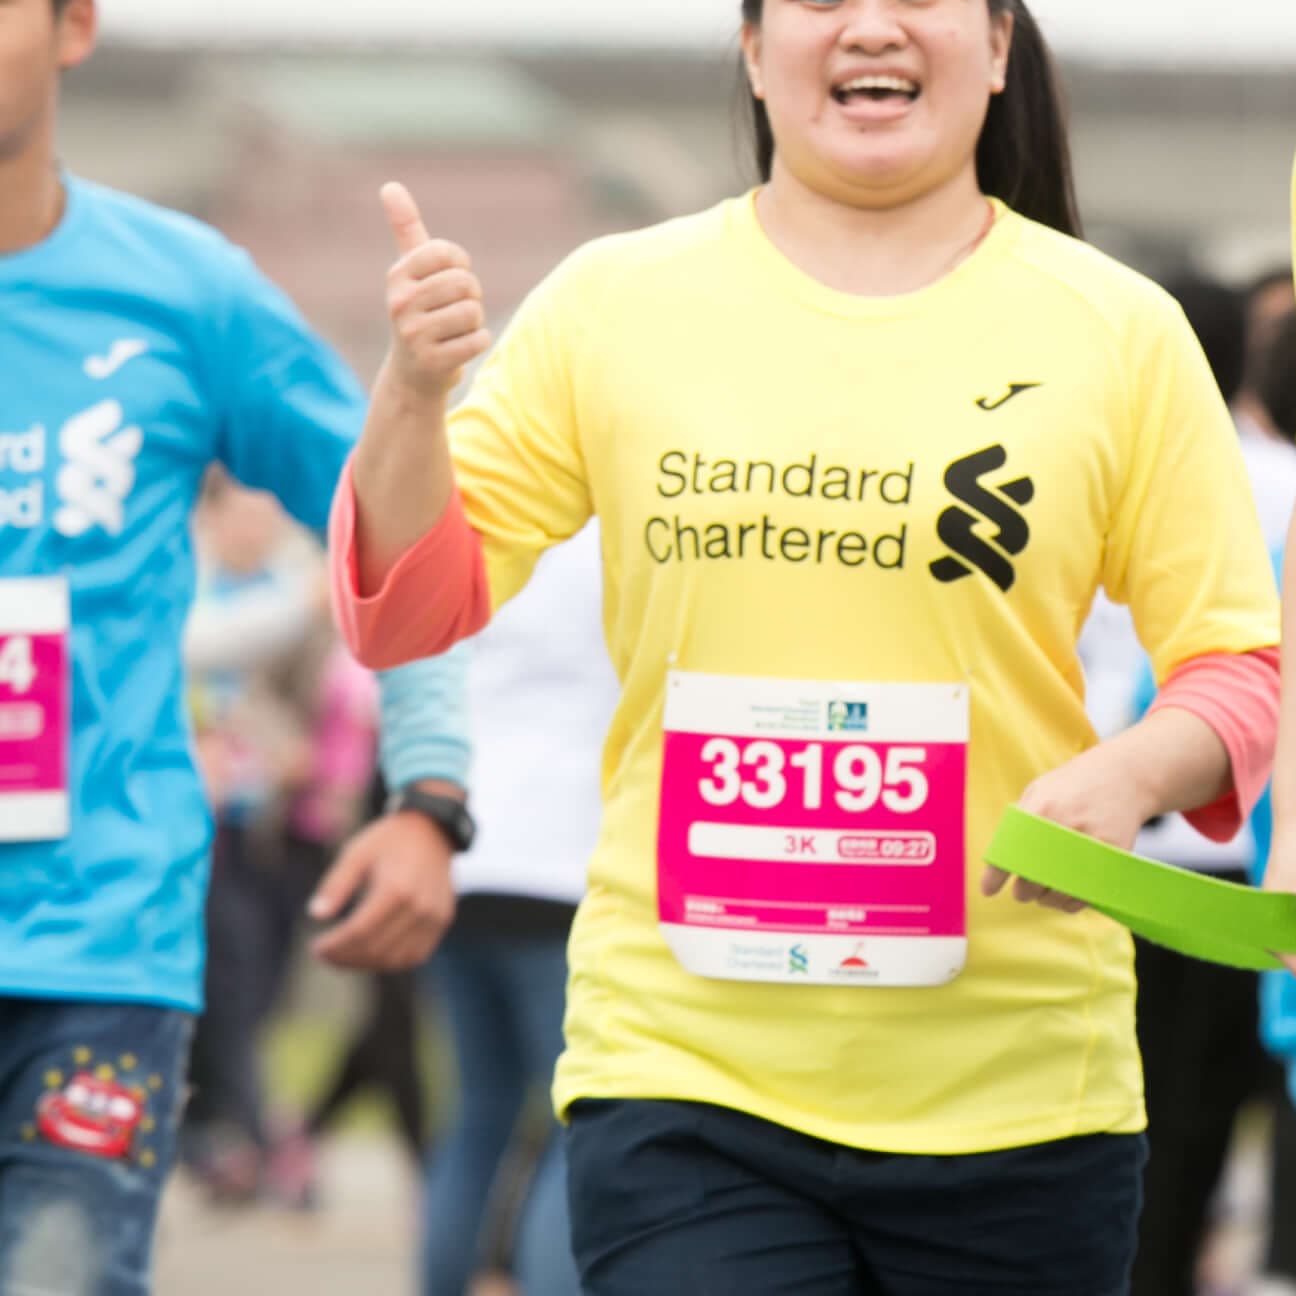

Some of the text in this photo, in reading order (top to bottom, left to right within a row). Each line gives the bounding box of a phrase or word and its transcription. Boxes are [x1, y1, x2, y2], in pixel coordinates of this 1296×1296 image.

[657, 450, 915, 504] Standard
[645, 515, 907, 569] Chartered
[698, 737, 929, 813] 33195
[784, 835, 816, 855] 3K
